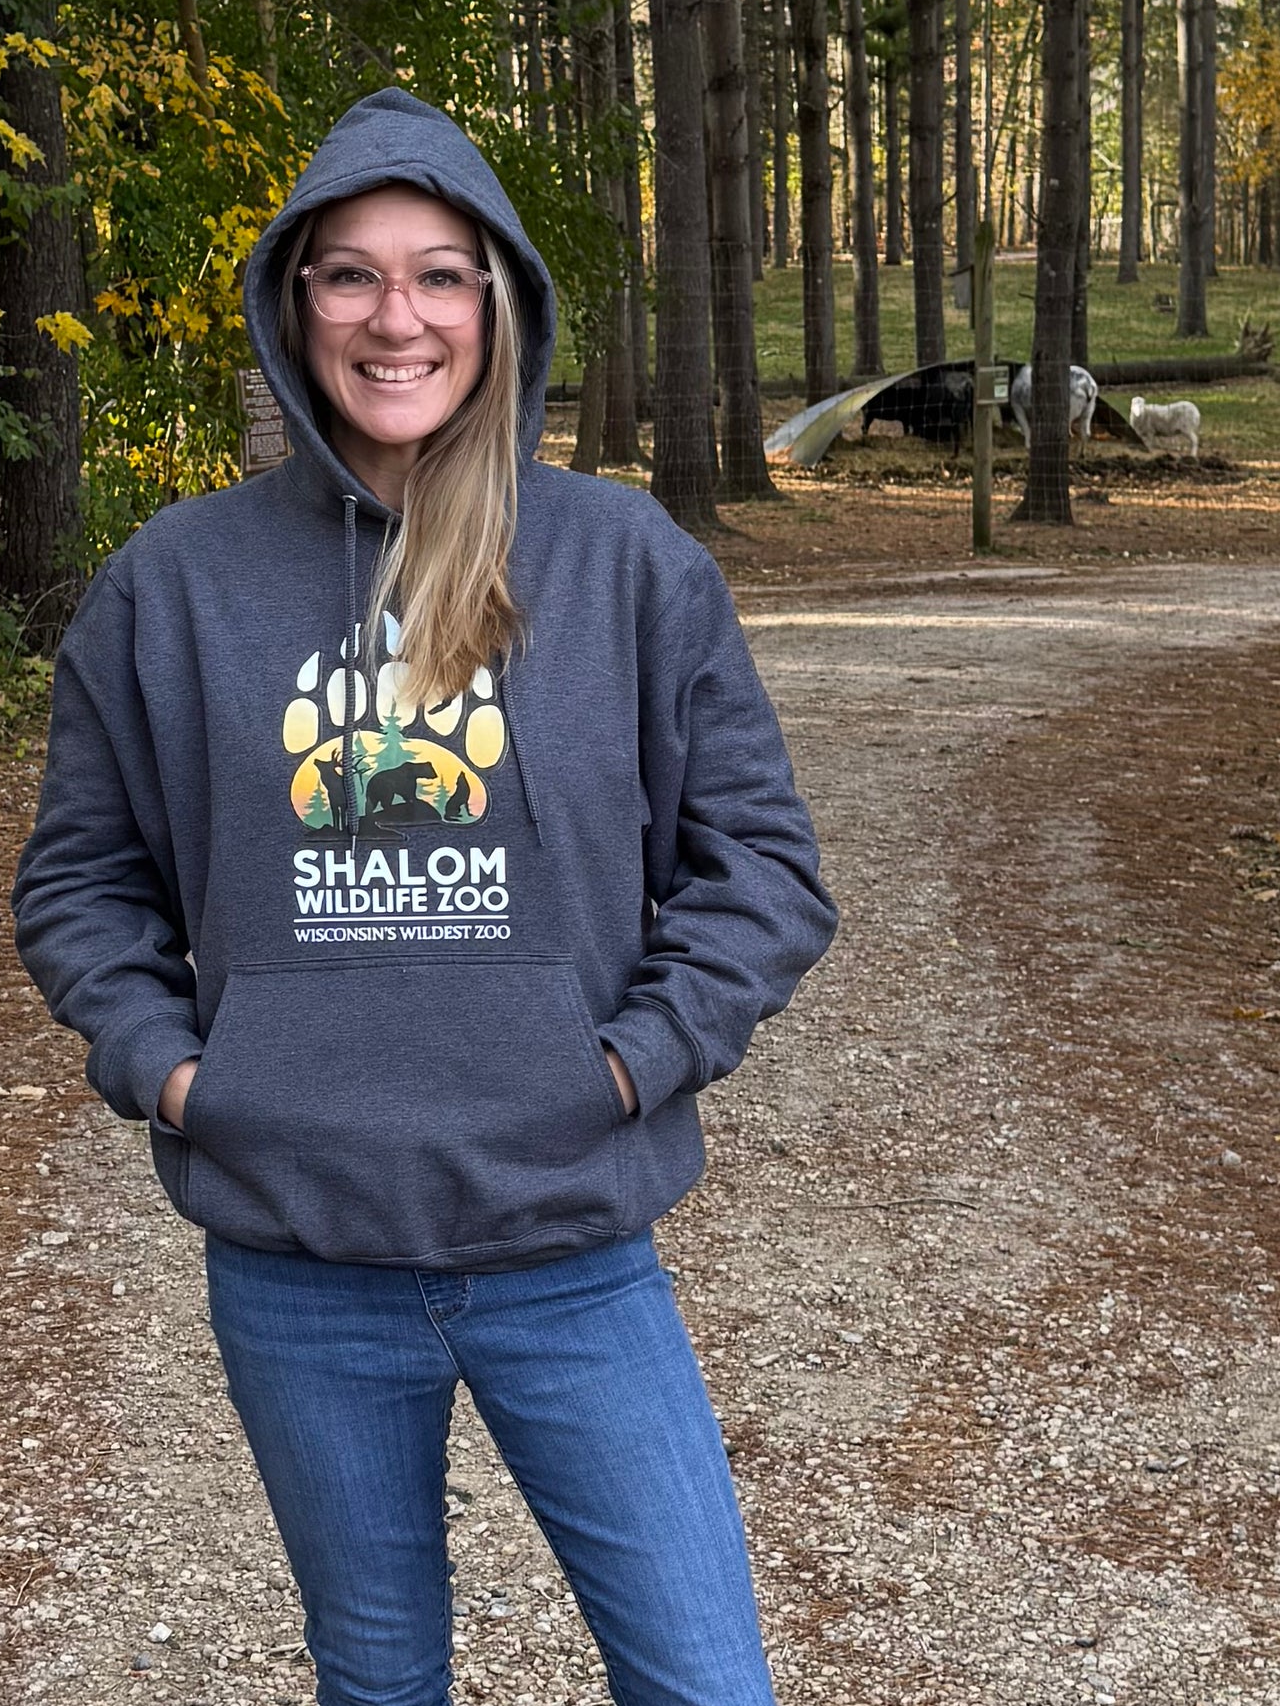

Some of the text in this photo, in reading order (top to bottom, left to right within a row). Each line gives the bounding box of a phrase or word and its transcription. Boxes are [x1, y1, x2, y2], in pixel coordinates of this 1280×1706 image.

[293, 846, 506, 888] SHALOM
[295, 885, 509, 914] WILDLIFE ZOO
[294, 925, 511, 943] WISCONSIN'S WILDEST ZOO
